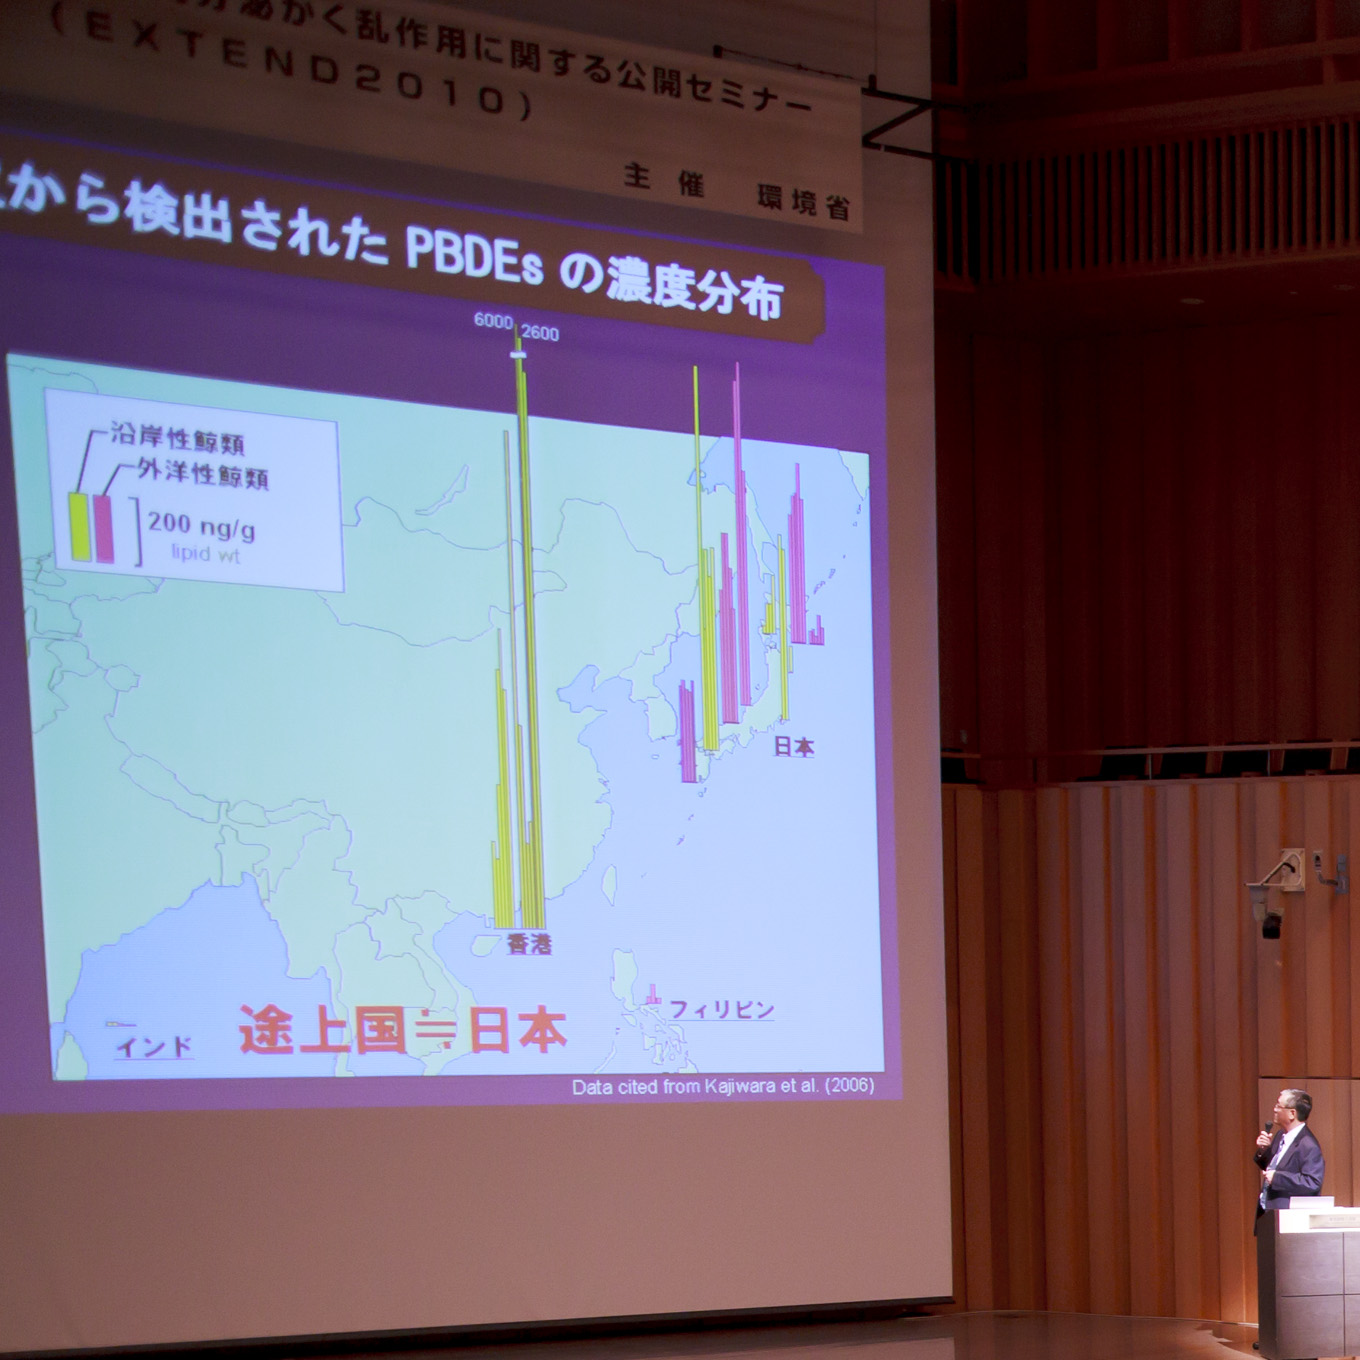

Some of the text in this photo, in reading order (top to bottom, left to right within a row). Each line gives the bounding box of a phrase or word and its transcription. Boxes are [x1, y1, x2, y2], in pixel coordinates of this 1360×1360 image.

[176, 0, 811, 112] 泌かく乱作用に関する公開セミナー
[757, 183, 850, 222] 環境省
[0, 159, 785, 322] から検出された PBDEs の濃度分布
[474, 312, 514, 330] 6000
[521, 323, 560, 342] 2600
[111, 421, 246, 457] 沿岸性鯨類
[137, 457, 269, 491] 外洋性鯨類
[148, 512, 255, 544] 200 ng/g
[172, 543, 241, 565] lipid wt
[774, 736, 815, 757] 日本
[507, 933, 552, 955] 香港
[117, 1036, 191, 1058] インド
[572, 1076, 875, 1097] Data cited from Kajiwara et al. (2006)
